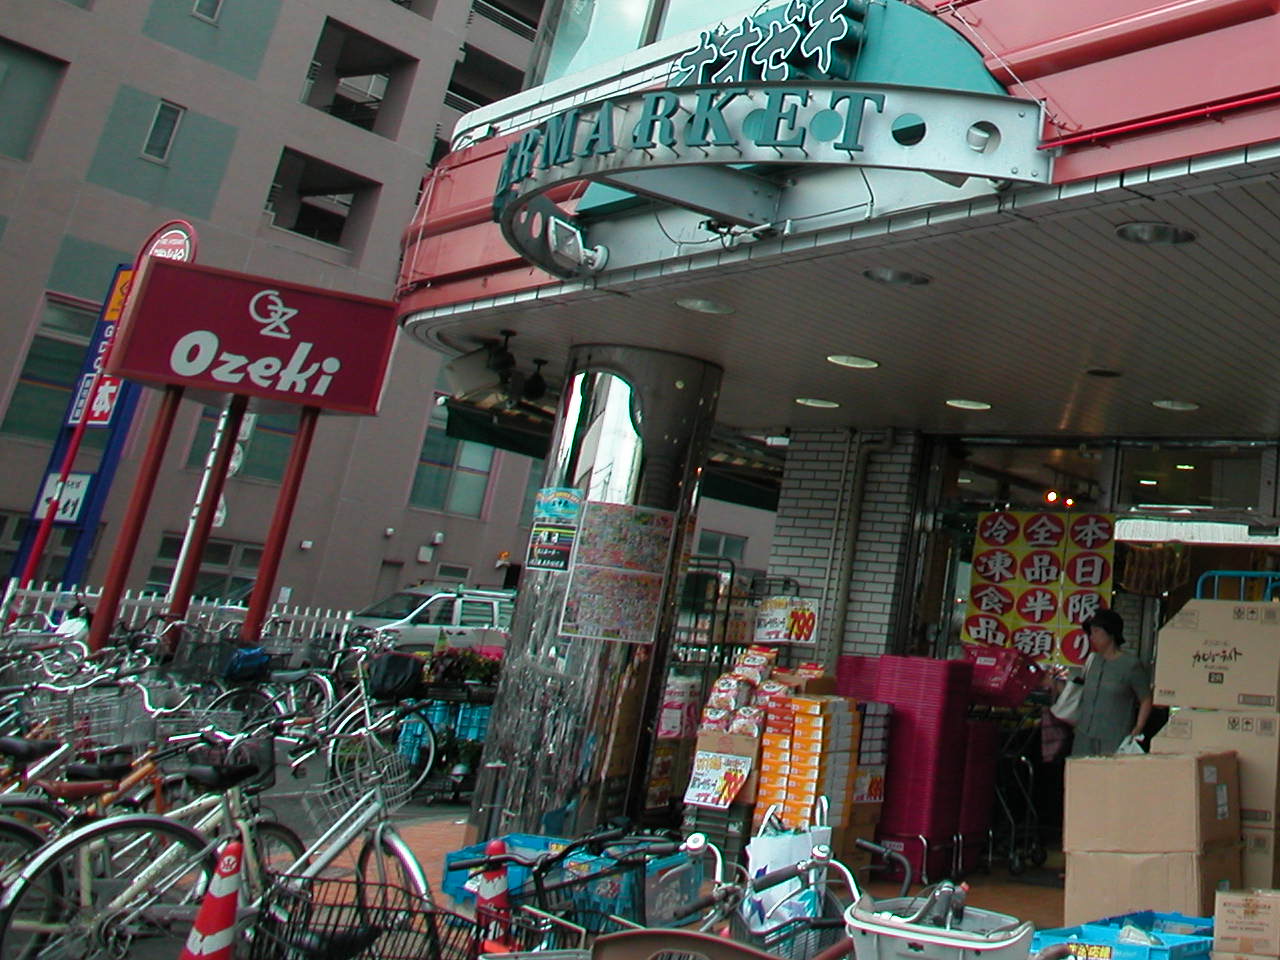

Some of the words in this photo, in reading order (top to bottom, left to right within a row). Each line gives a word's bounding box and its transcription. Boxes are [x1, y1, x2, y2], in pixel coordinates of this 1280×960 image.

[169, 330, 341, 396] Ozeki
[968, 514, 1016, 646] 冷凍食品
[1012, 515, 1063, 661] 全品半額
[1056, 517, 1110, 661] 本日限り
